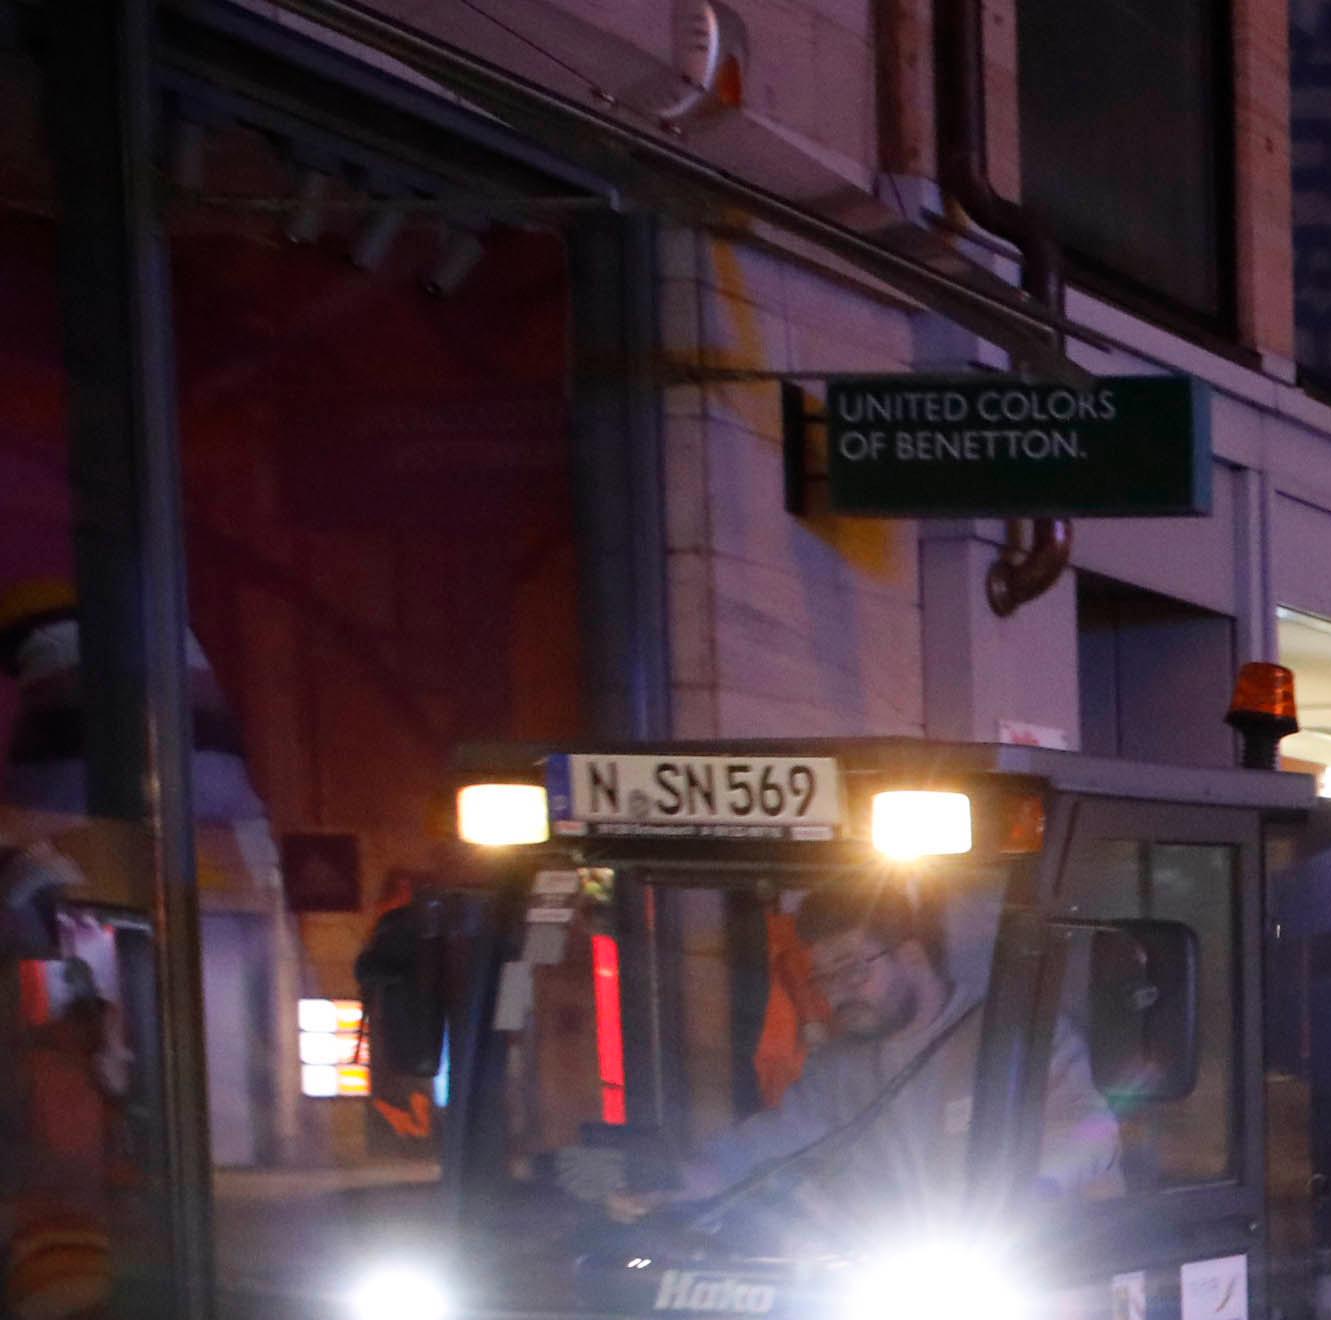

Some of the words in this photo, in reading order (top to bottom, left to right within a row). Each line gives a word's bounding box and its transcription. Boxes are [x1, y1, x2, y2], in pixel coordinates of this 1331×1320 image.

[838, 390, 968, 423] UNITED
[977, 389, 1117, 423] COLORS
[839, 430, 888, 462] OF
[587, 760, 621, 814] N
